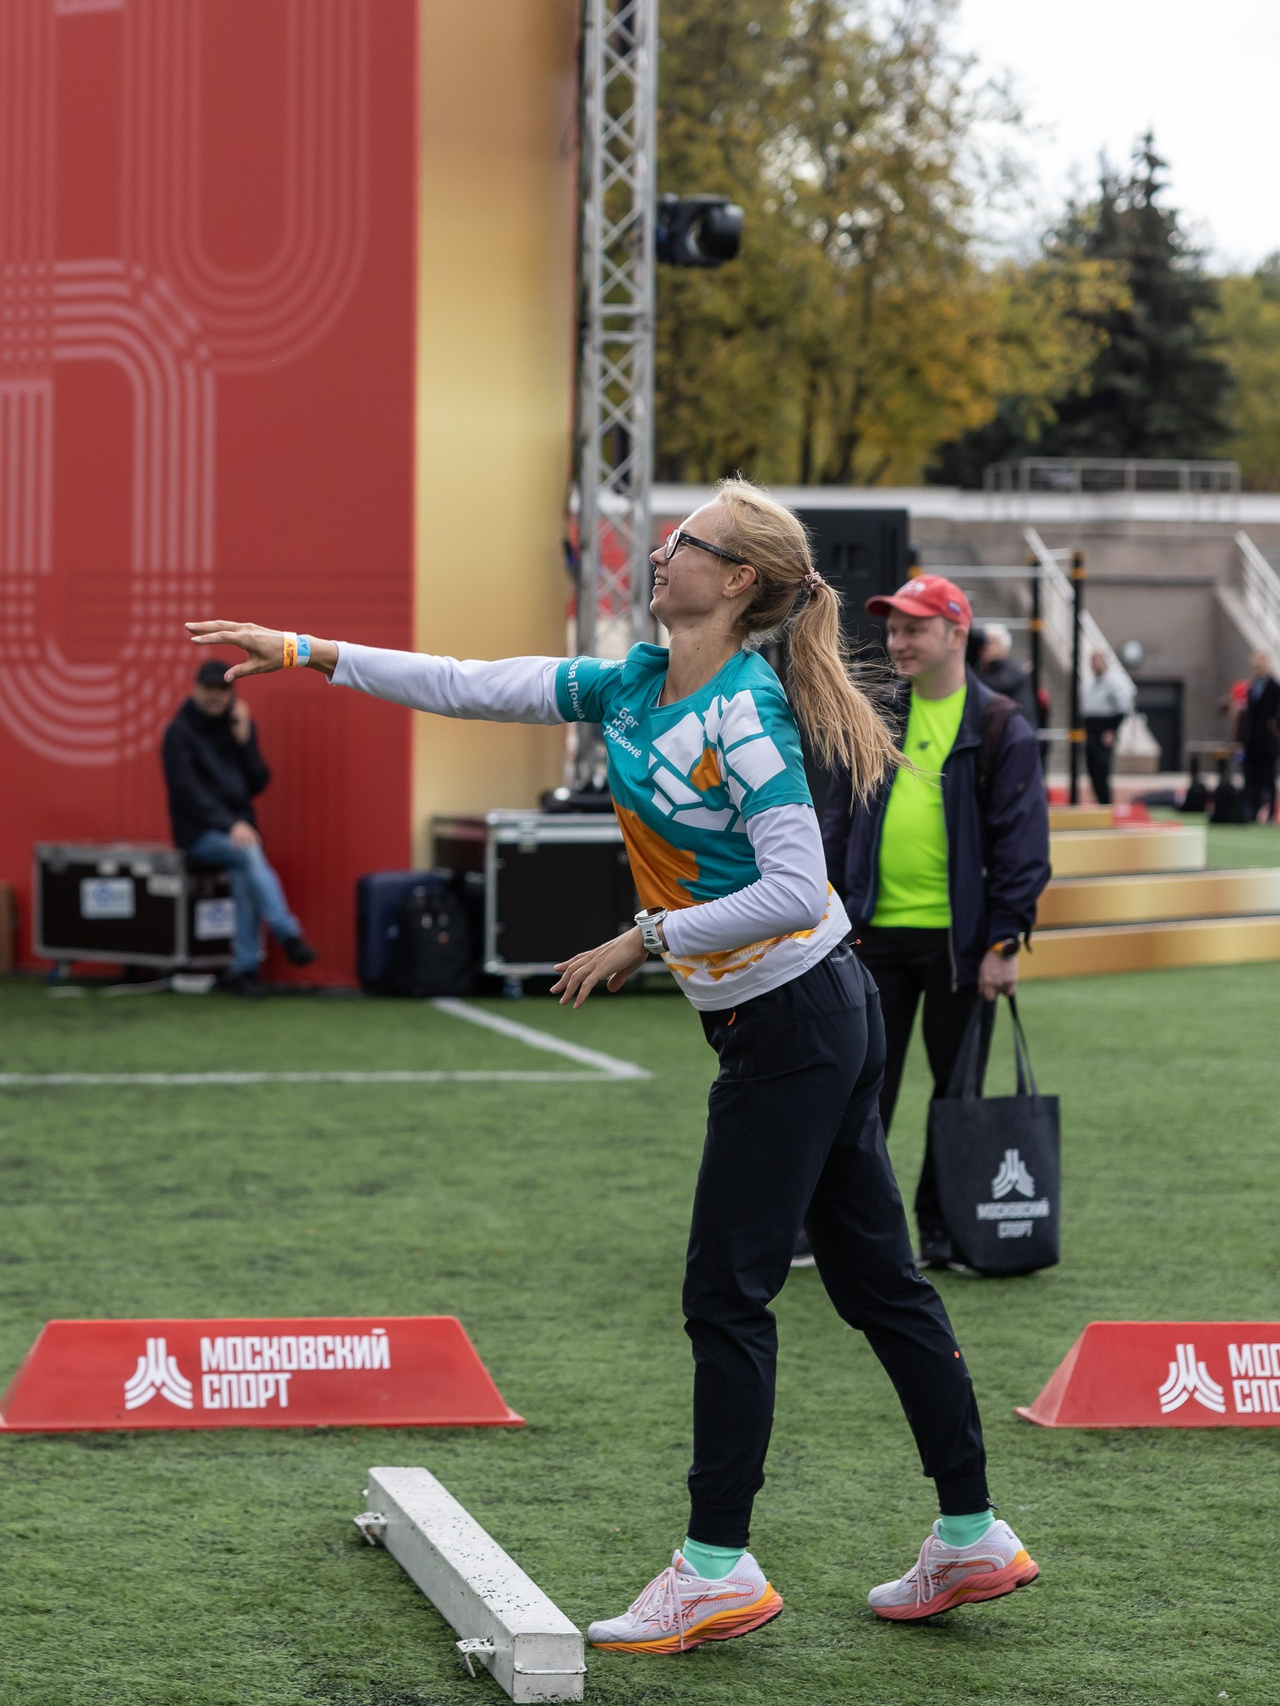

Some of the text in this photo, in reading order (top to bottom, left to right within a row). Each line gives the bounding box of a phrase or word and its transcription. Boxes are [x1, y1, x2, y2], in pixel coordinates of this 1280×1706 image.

[611, 717, 627, 734] на
[618, 707, 640, 729] бег
[603, 725, 642, 759] районе
[200, 1328, 391, 1372] МОСКОВСКИЙ
[201, 1372, 293, 1409] СПОРТ
